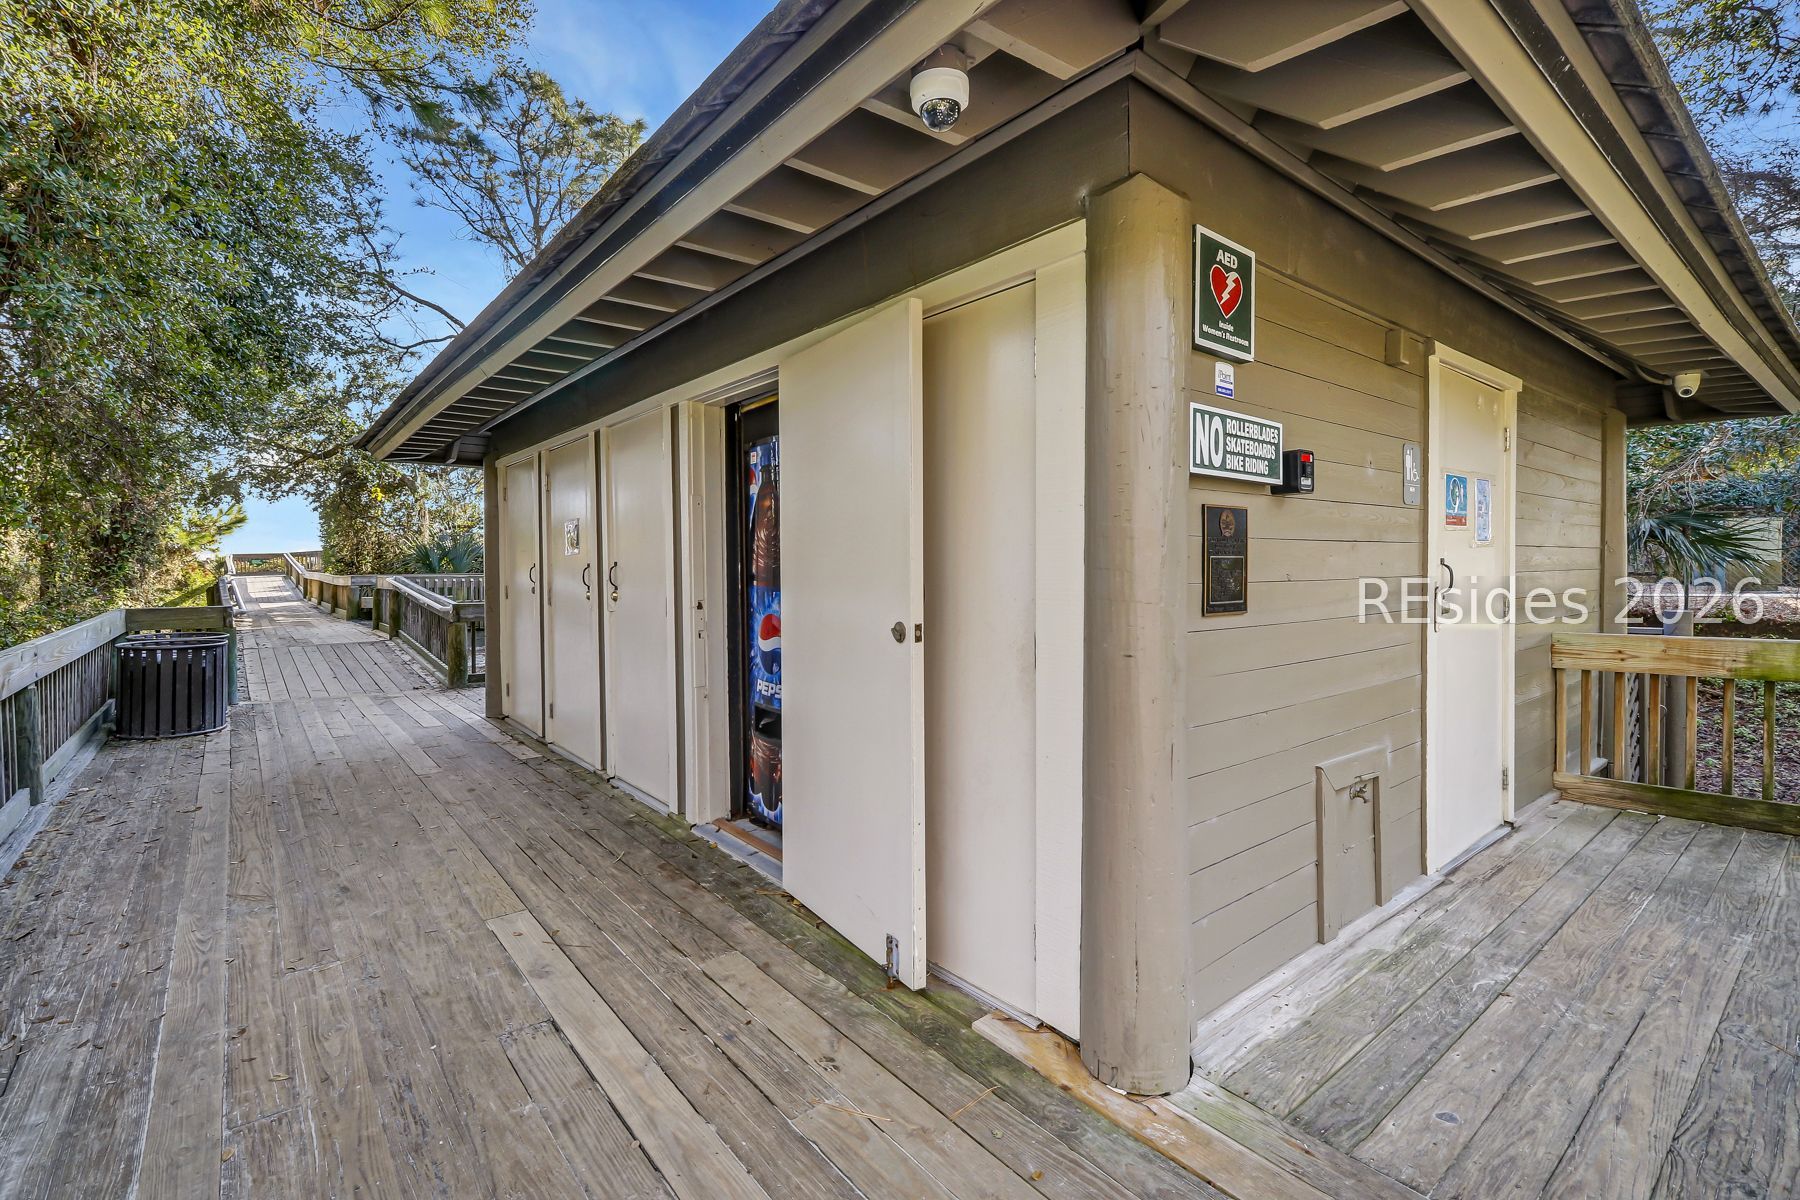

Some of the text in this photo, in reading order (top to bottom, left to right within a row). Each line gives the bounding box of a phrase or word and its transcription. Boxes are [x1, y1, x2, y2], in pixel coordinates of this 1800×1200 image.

[1216, 249, 1238, 269] AED
[1202, 323, 1249, 347] Women's Restroom
[1218, 320, 1234, 332] Inside
[1195, 412, 1224, 468] NO
[1226, 418, 1279, 444] ROLLERBLADES
[1226, 436, 1276, 460] SKATEBOARDS
[1226, 454, 1269, 475] BIKE RIDING
[756, 679, 782, 698] PEPS
